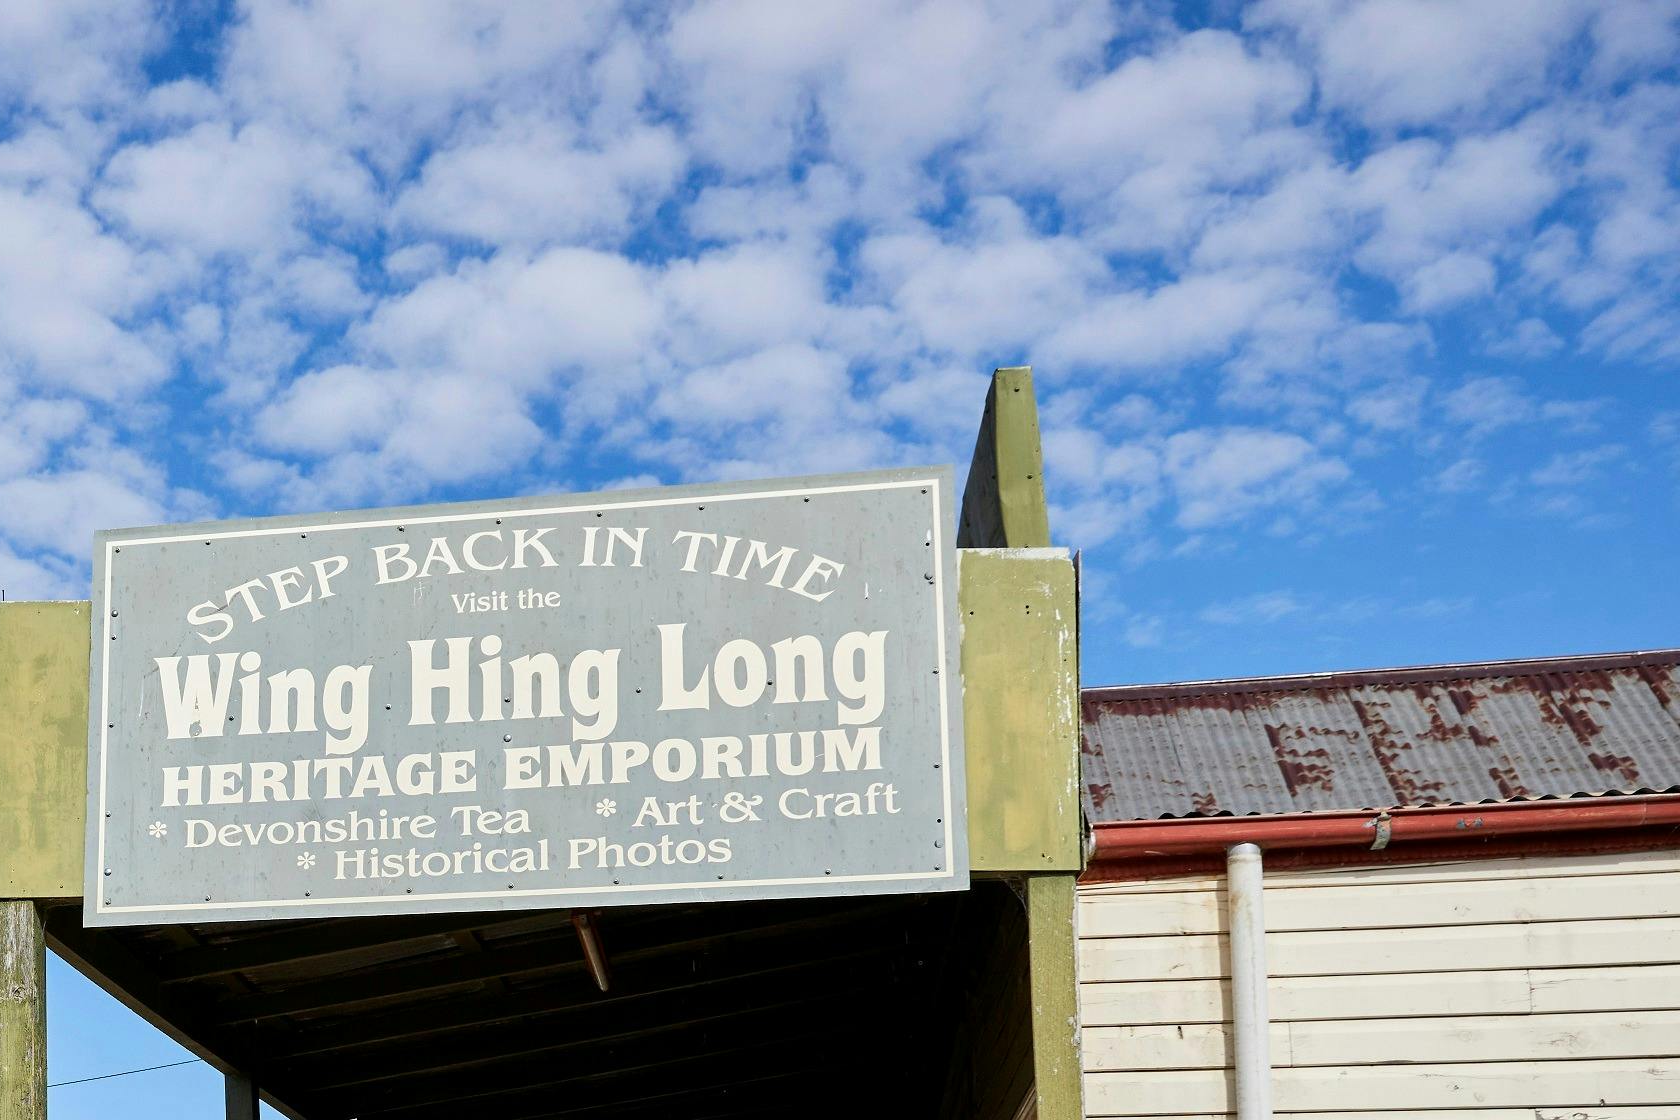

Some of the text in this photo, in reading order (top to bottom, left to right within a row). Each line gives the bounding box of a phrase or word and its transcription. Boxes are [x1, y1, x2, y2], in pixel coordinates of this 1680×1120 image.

[186, 526, 846, 645] STEP BACK IN TIME
[450, 587, 561, 614] Visit the
[152, 622, 890, 757] Wing Hing Long
[159, 727, 884, 808] HERITAGE EMPORIUM
[183, 782, 902, 851] Devonshire Tea Art & Craft
[333, 834, 733, 882] Historical Photos
